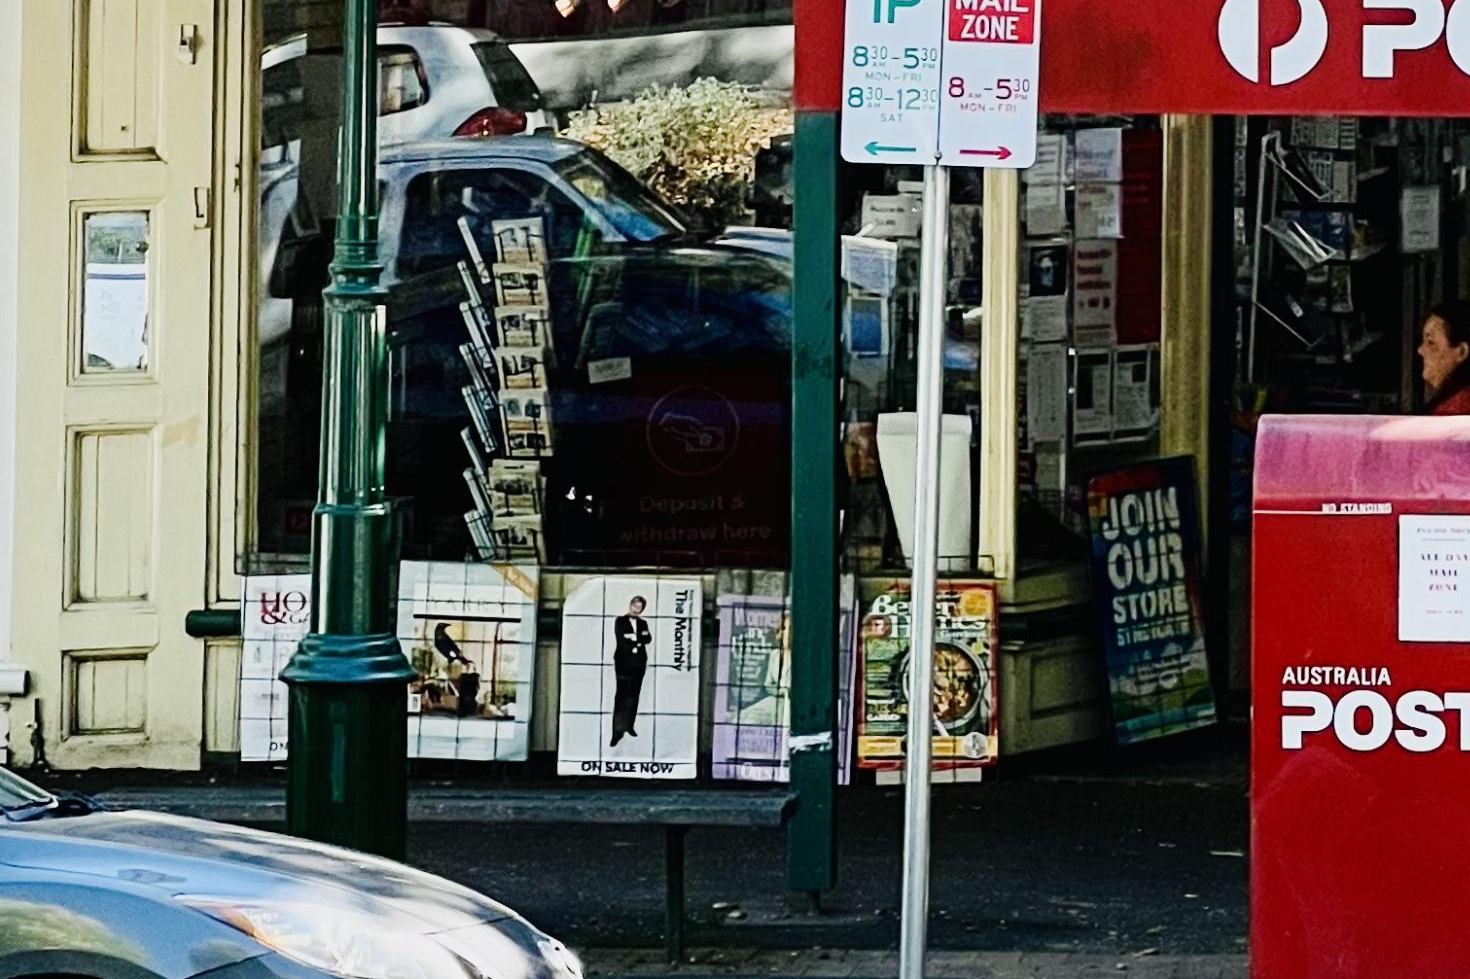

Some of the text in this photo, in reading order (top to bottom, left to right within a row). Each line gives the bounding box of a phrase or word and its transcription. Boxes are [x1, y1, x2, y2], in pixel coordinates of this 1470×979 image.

[961, 14, 1019, 41] ZONE
[880, 113, 902, 122] SAT
[639, 495, 724, 516] Deposit
[1102, 487, 1180, 540] JOIN
[618, 522, 772, 544] withdraw here
[1107, 532, 1184, 590] OUR
[1112, 585, 1189, 624] STORE
[673, 589, 688, 672] The Monthly
[1282, 667, 1391, 685] AUSTRALIA
[581, 761, 675, 774] ON SALE NOW
